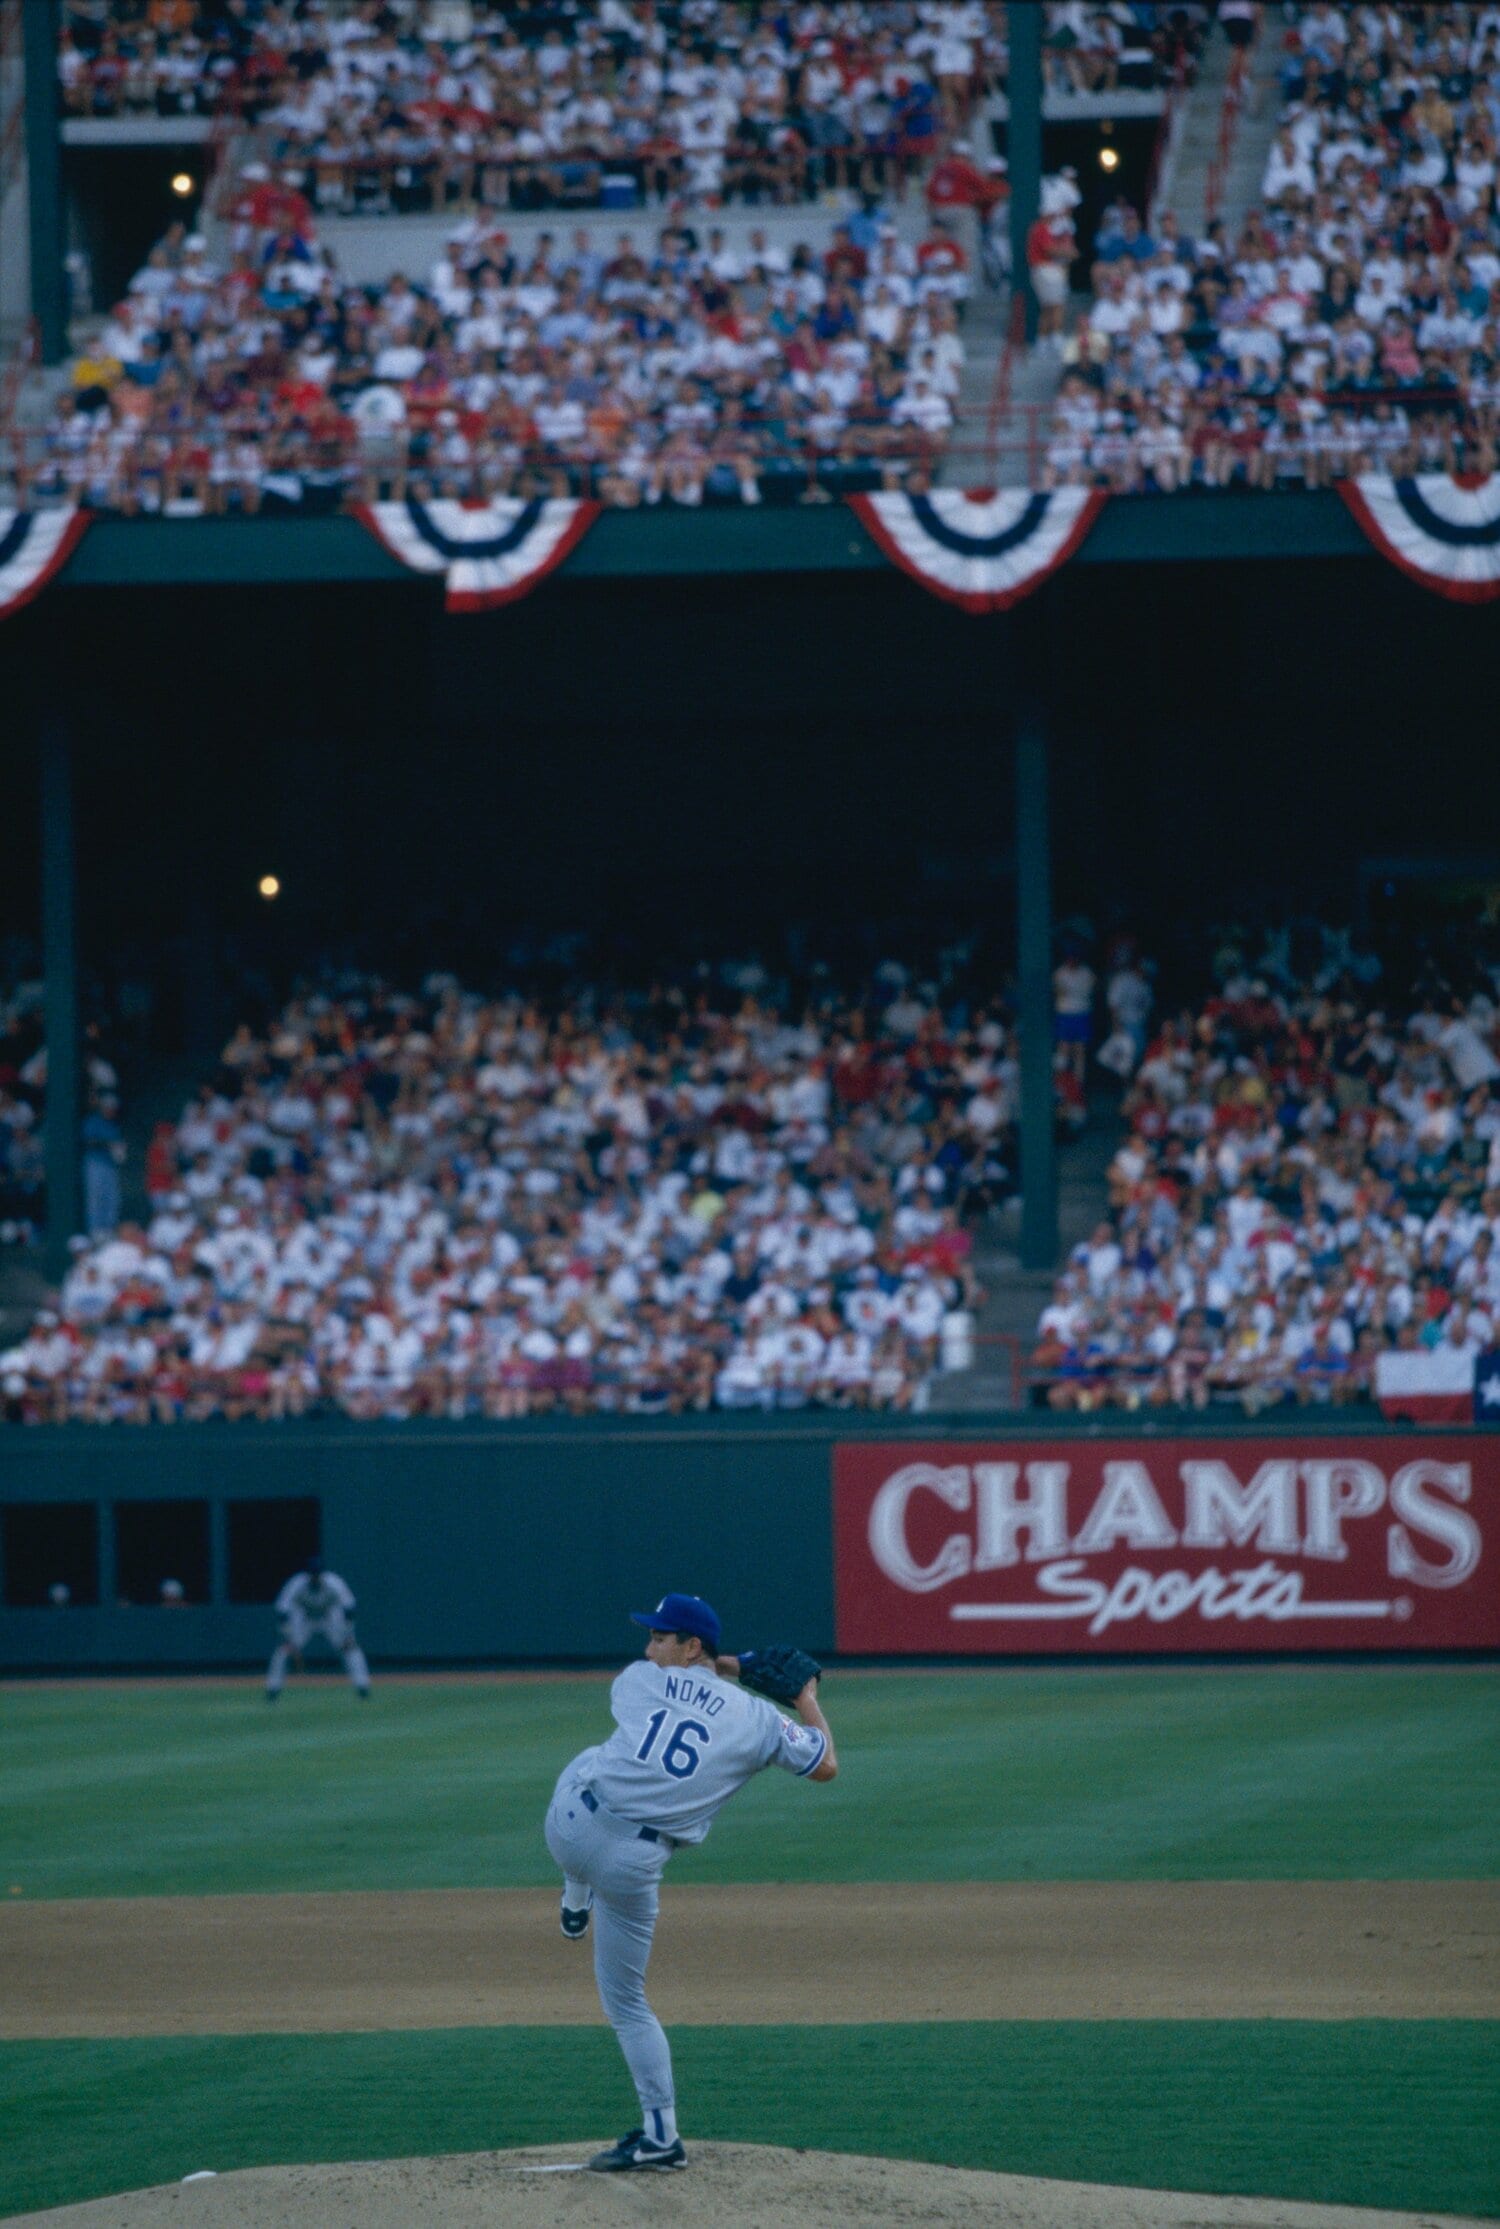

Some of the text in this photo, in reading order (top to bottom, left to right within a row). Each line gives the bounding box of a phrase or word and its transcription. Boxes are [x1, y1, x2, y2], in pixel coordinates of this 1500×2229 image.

[868, 1459, 1483, 1593] CHAMPS
[1036, 1559, 1304, 1637] Sports
[664, 1674, 726, 1717] NOMO
[635, 1707, 711, 1780] 16
